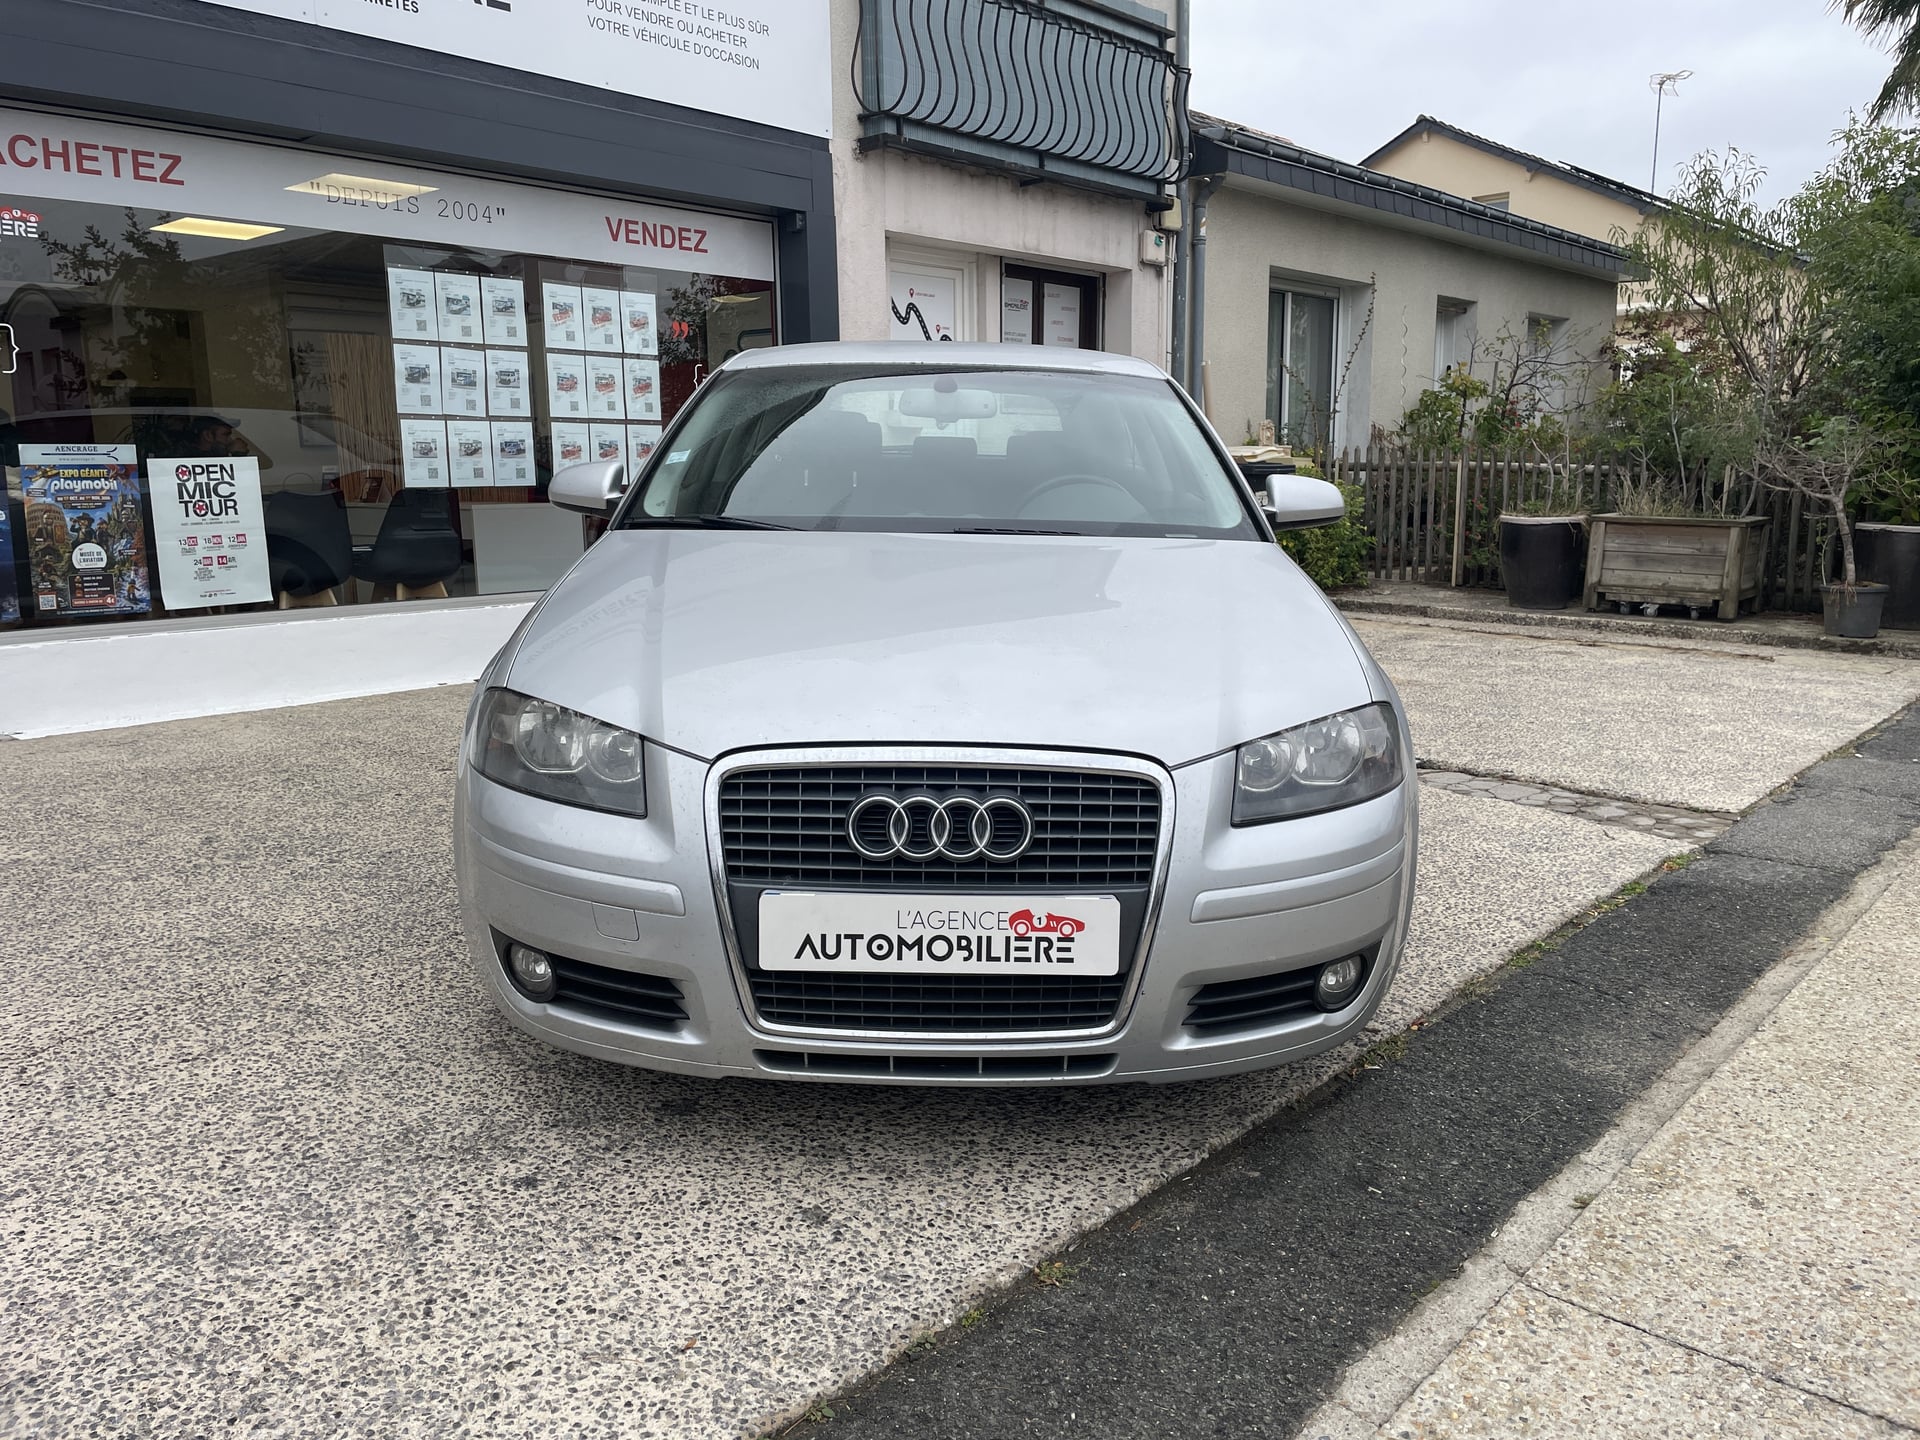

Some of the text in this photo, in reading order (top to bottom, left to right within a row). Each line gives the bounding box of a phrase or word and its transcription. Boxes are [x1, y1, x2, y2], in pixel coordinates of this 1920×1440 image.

[625, 4, 674, 30] VENDRE
[676, 19, 695, 35] OU
[696, 25, 748, 49] ACHETER
[684, 2, 699, 17] ET
[701, 6, 715, 22] LE
[717, 11, 746, 30] PLUS
[748, 19, 771, 37] SÛR
[587, 14, 760, 71] VOTRE VÉHICULE D'OCCASION
[0, 134, 185, 186] CHETEZ
[604, 215, 710, 255] VENDEZ
[60, 467, 109, 478] EXPO GÉANTE
[175, 463, 236, 483] OPEN
[50, 478, 118, 493] playmobil
[176, 480, 237, 500] MIC
[178, 498, 240, 518] TOUR
[897, 910, 1010, 931] L'AGENCE
